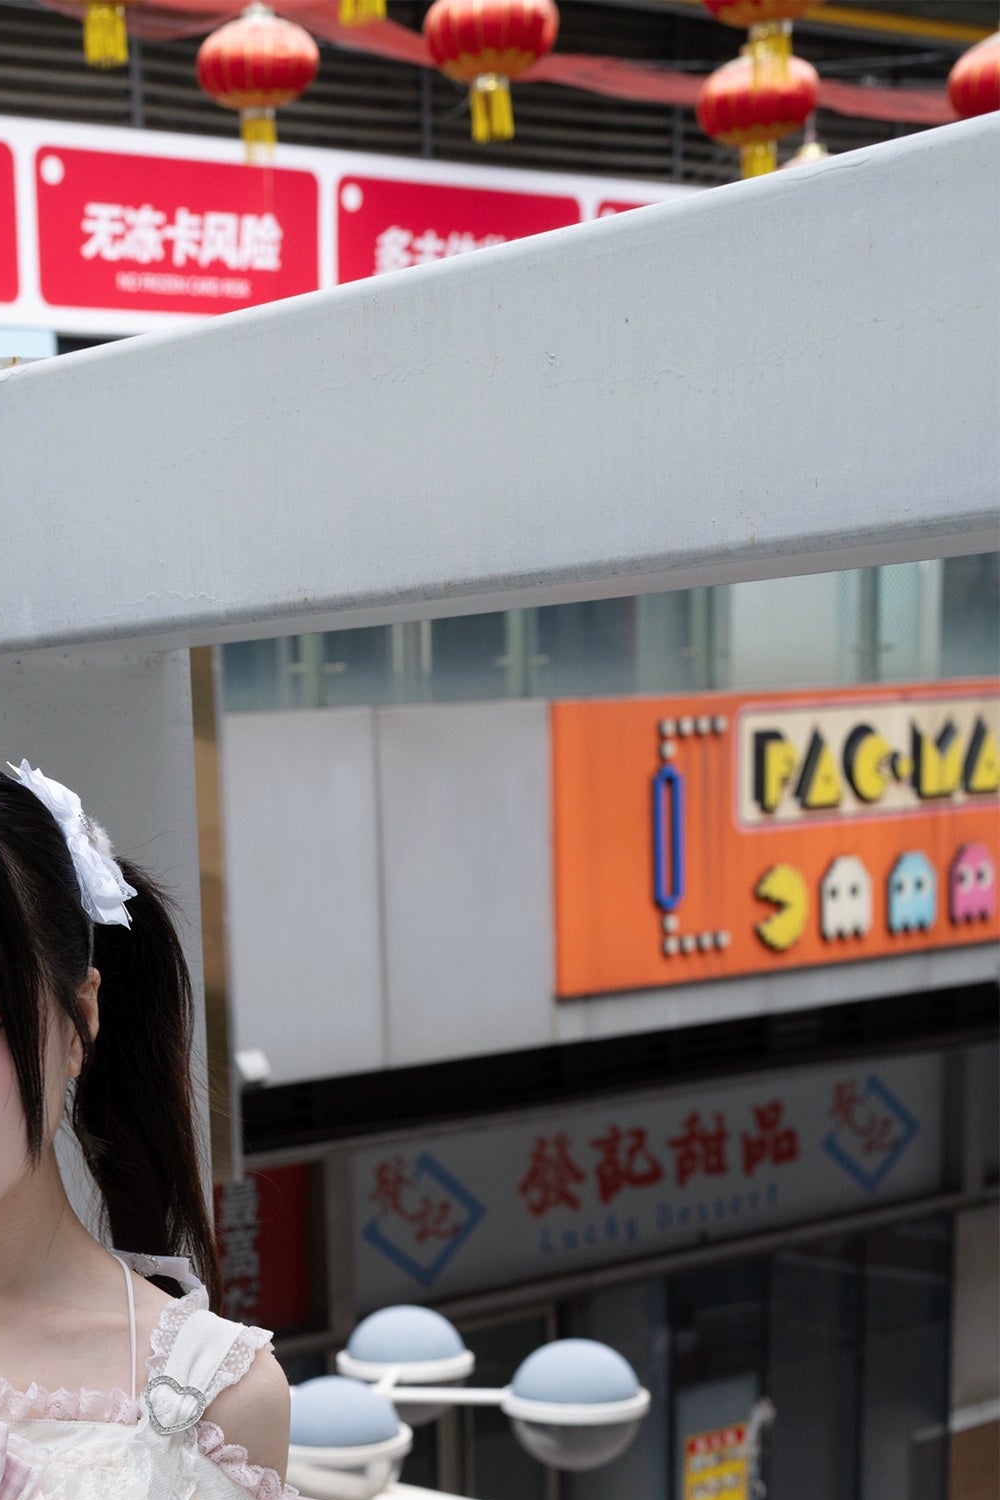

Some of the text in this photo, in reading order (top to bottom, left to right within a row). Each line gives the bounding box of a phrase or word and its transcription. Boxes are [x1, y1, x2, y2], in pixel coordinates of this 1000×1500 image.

[81, 202, 283, 272] 无冻卡风险
